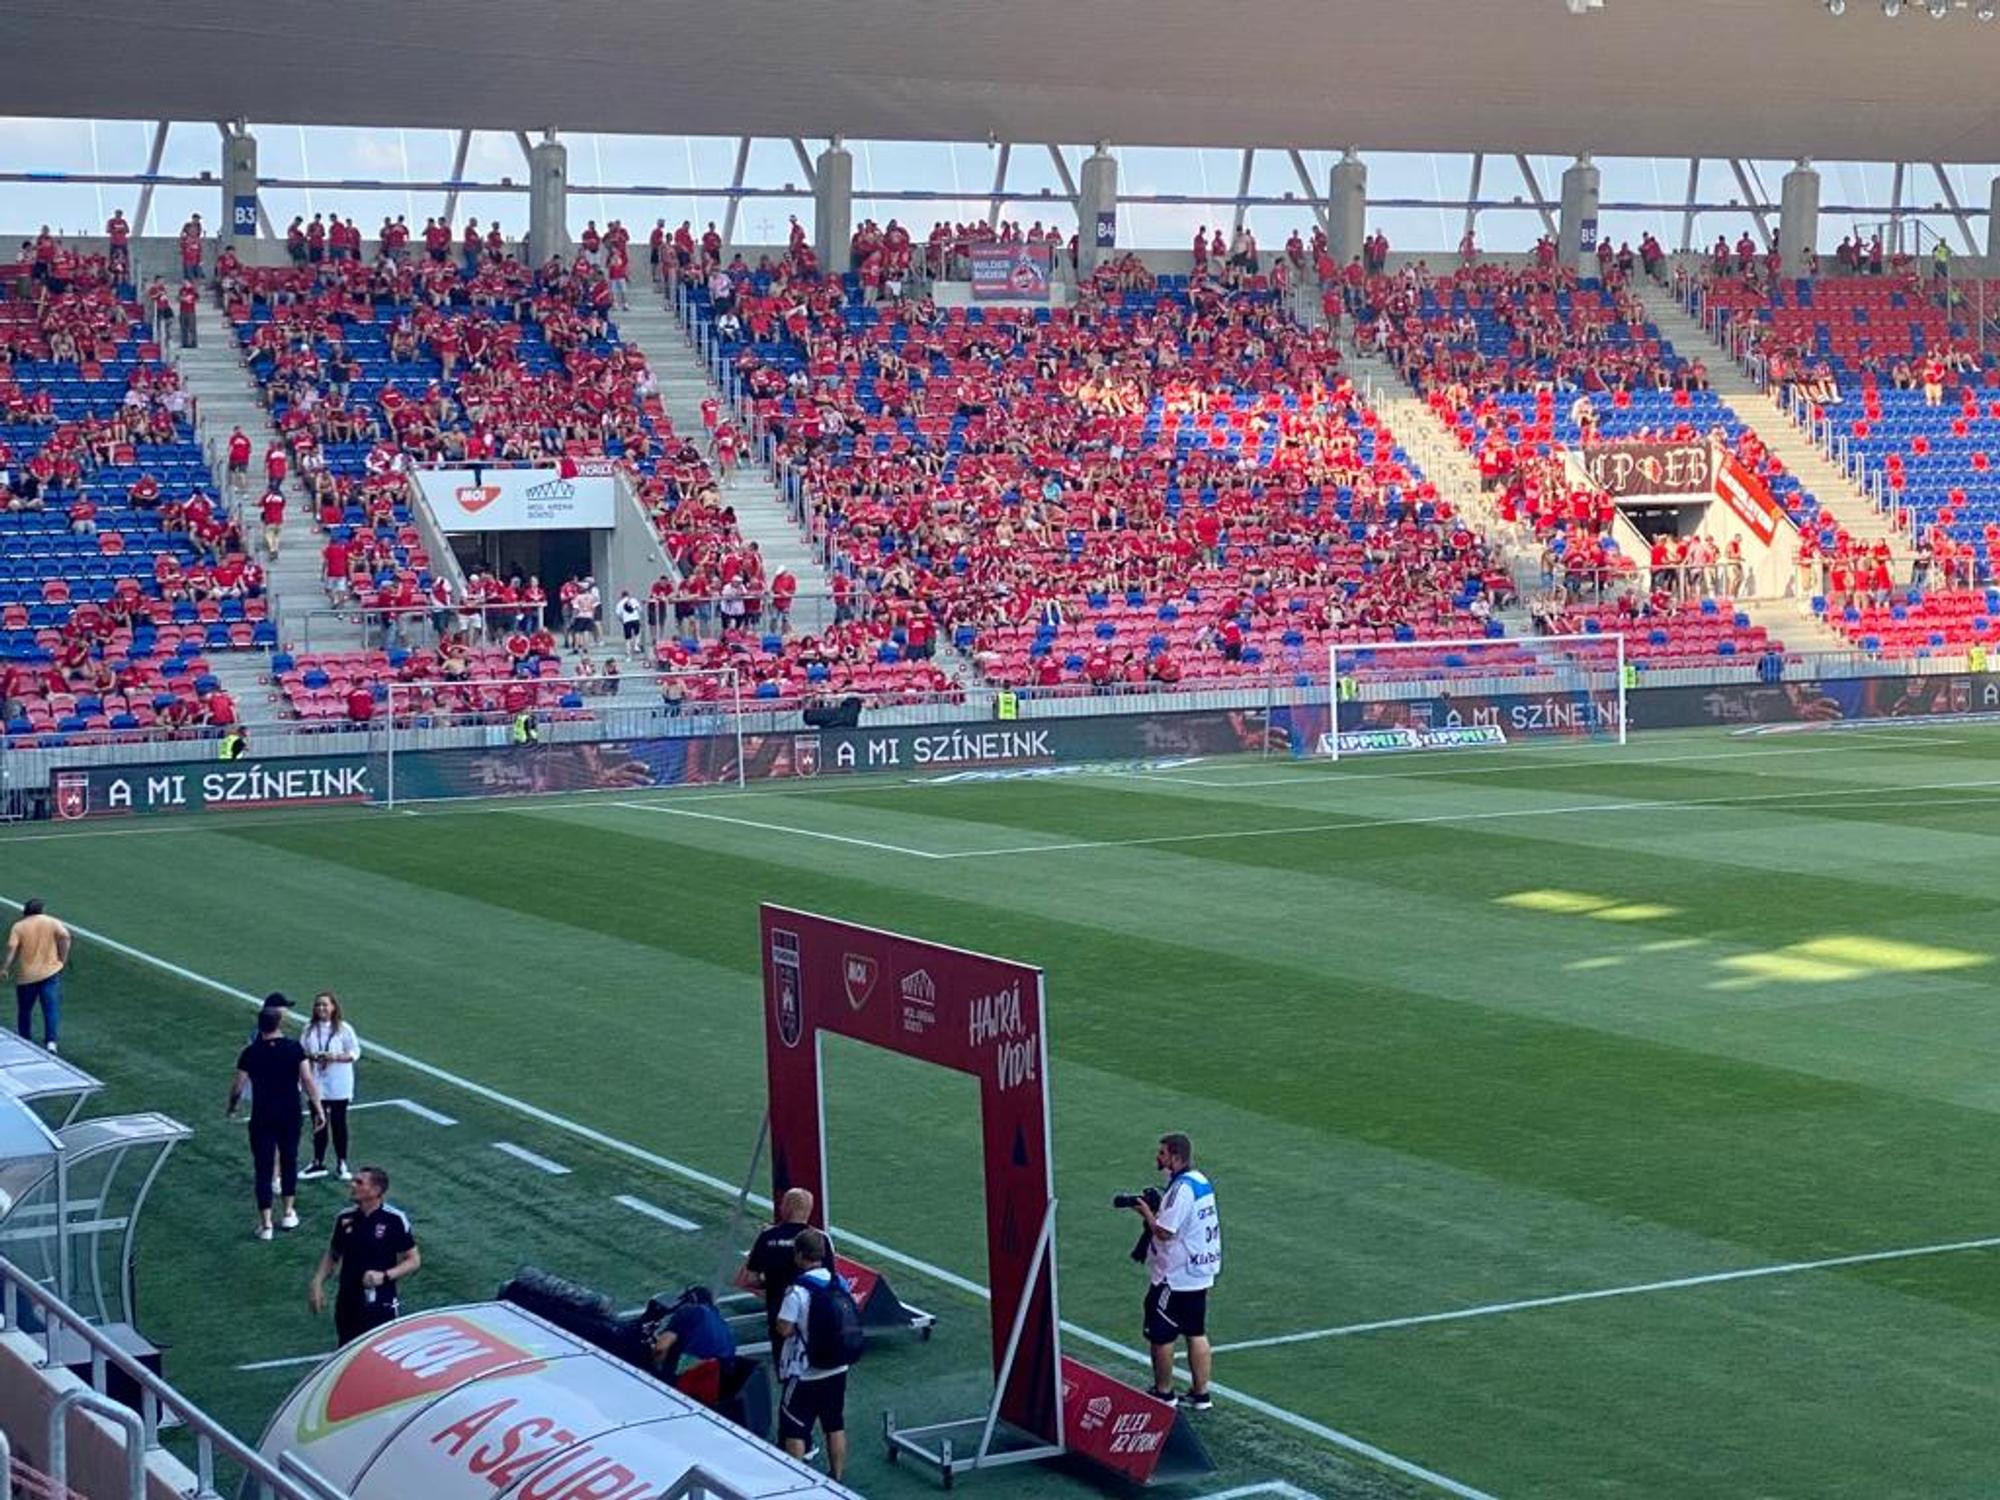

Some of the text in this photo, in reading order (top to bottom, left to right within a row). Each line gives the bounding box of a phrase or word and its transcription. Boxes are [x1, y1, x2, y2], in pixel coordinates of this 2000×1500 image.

[234, 206, 255, 224] B3
[1098, 222, 1114, 238] B4
[1581, 228, 1596, 243] B5
[1447, 708, 1462, 727] A
[1473, 706, 1500, 726] MI
[837, 728, 1056, 767] A MI SZÍNEINK.
[109, 764, 375, 807] A MI SZÍNEINK.
[372, 1325, 494, 1378] MOL
[430, 1398, 662, 1500] A SZUR
